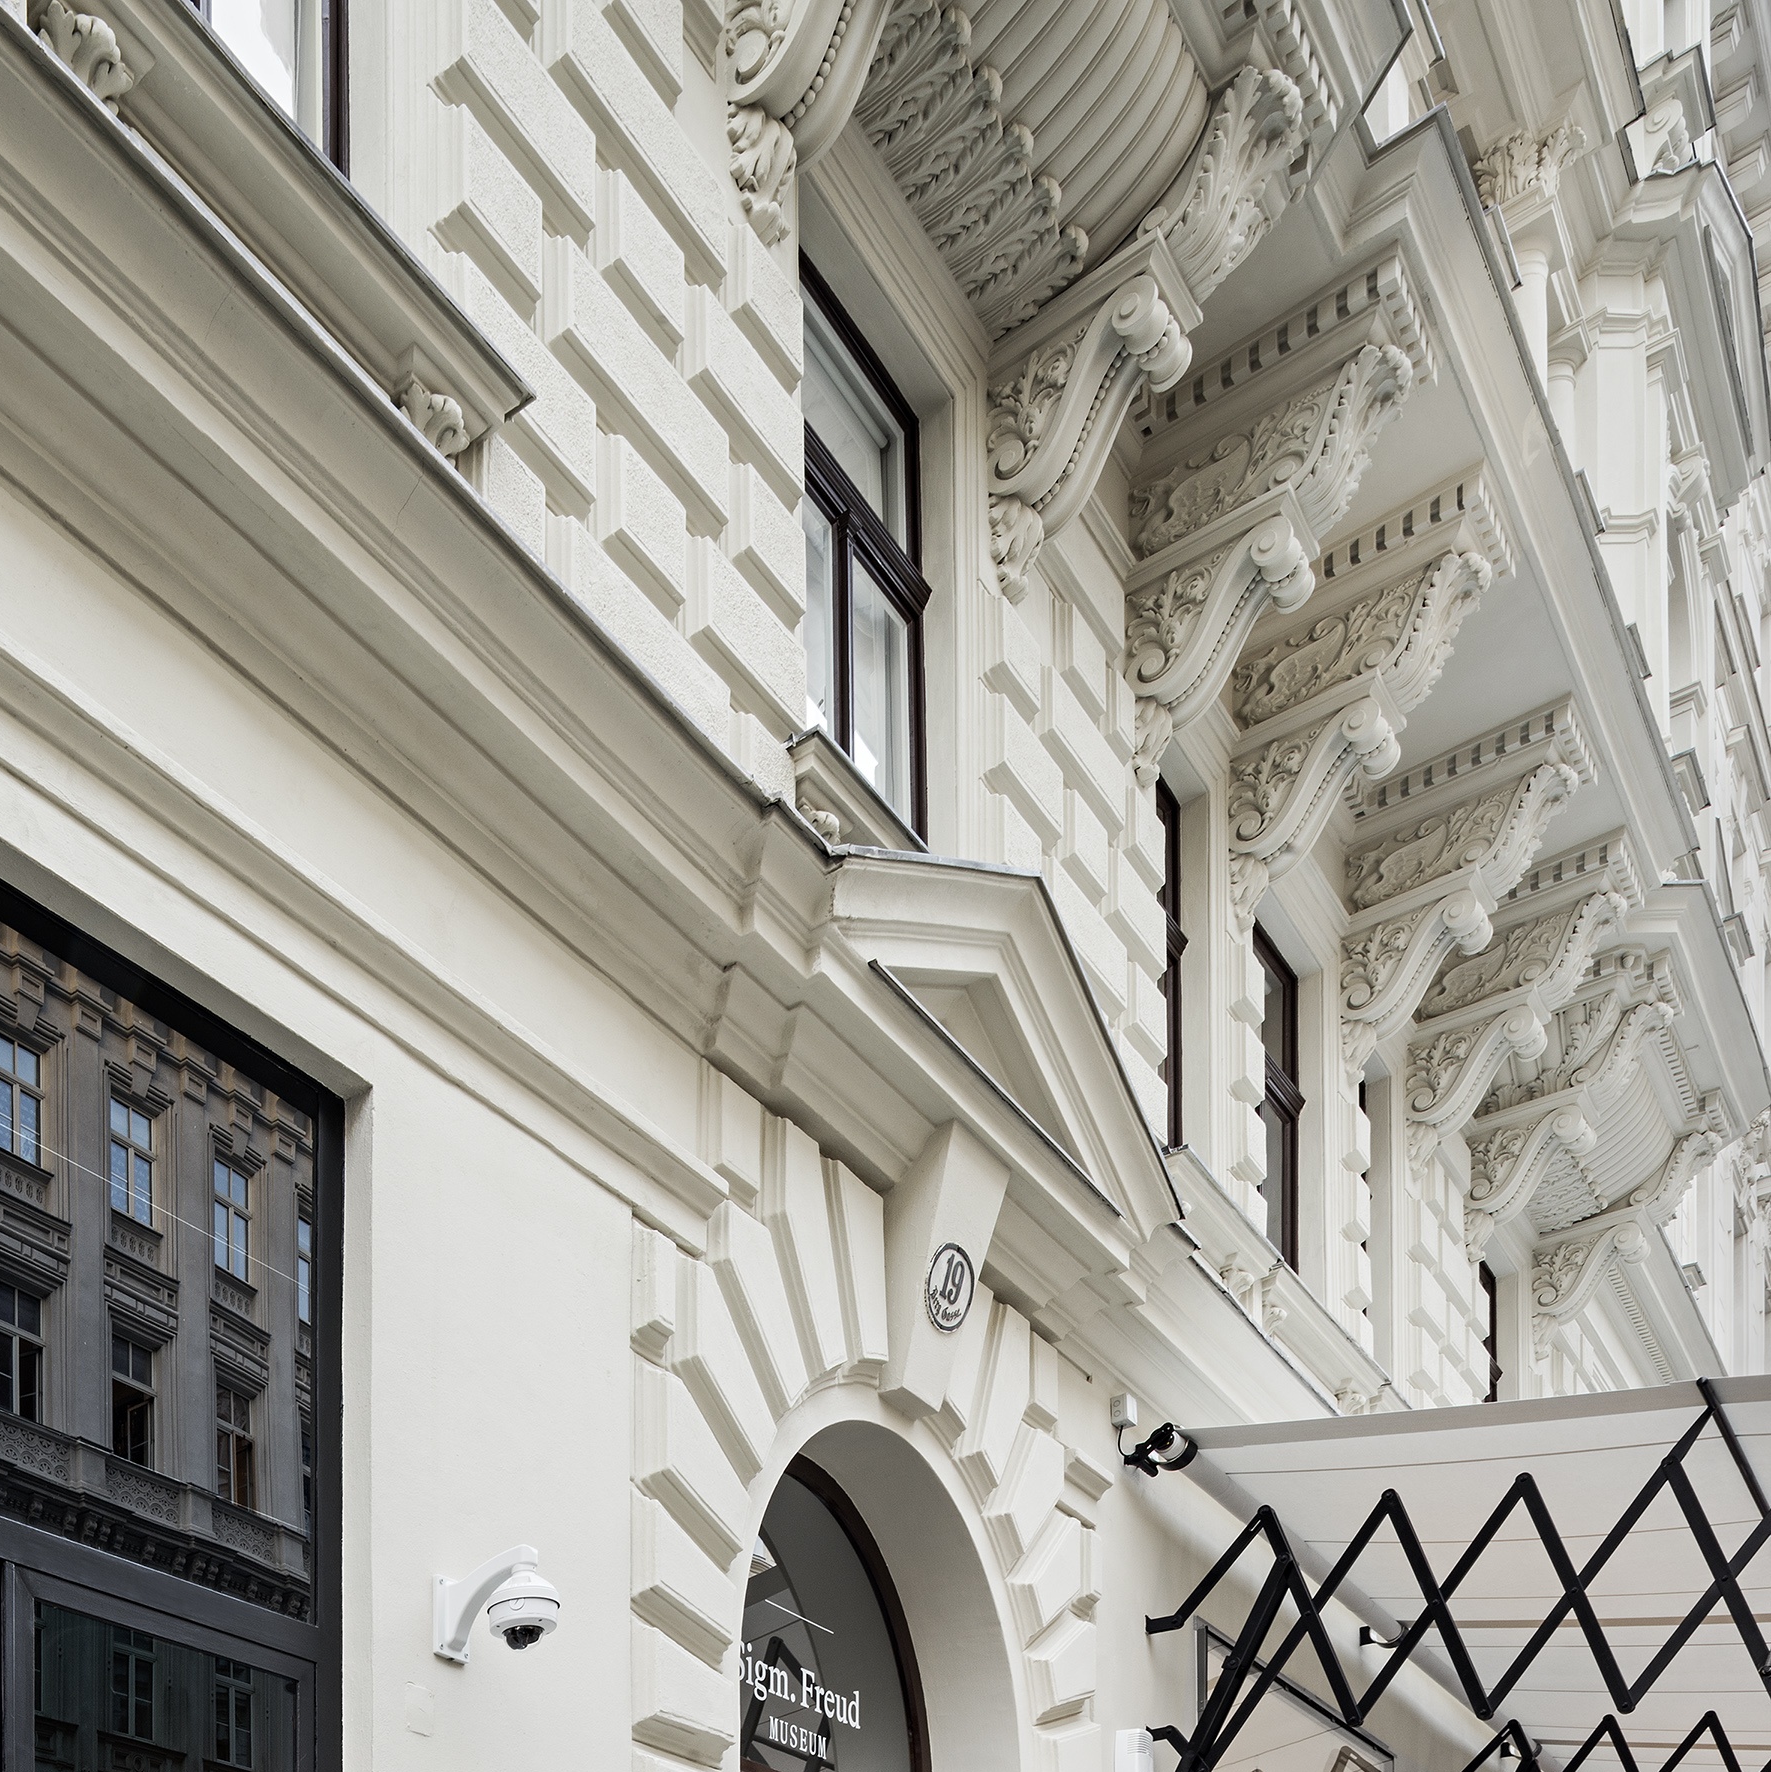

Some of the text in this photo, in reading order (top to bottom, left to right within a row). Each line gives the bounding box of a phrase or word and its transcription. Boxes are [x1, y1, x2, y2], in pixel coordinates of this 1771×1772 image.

[939, 1254, 965, 1305] 19
[800, 1667, 861, 1730] Freud
[769, 1716, 827, 1760] MUSEUM
